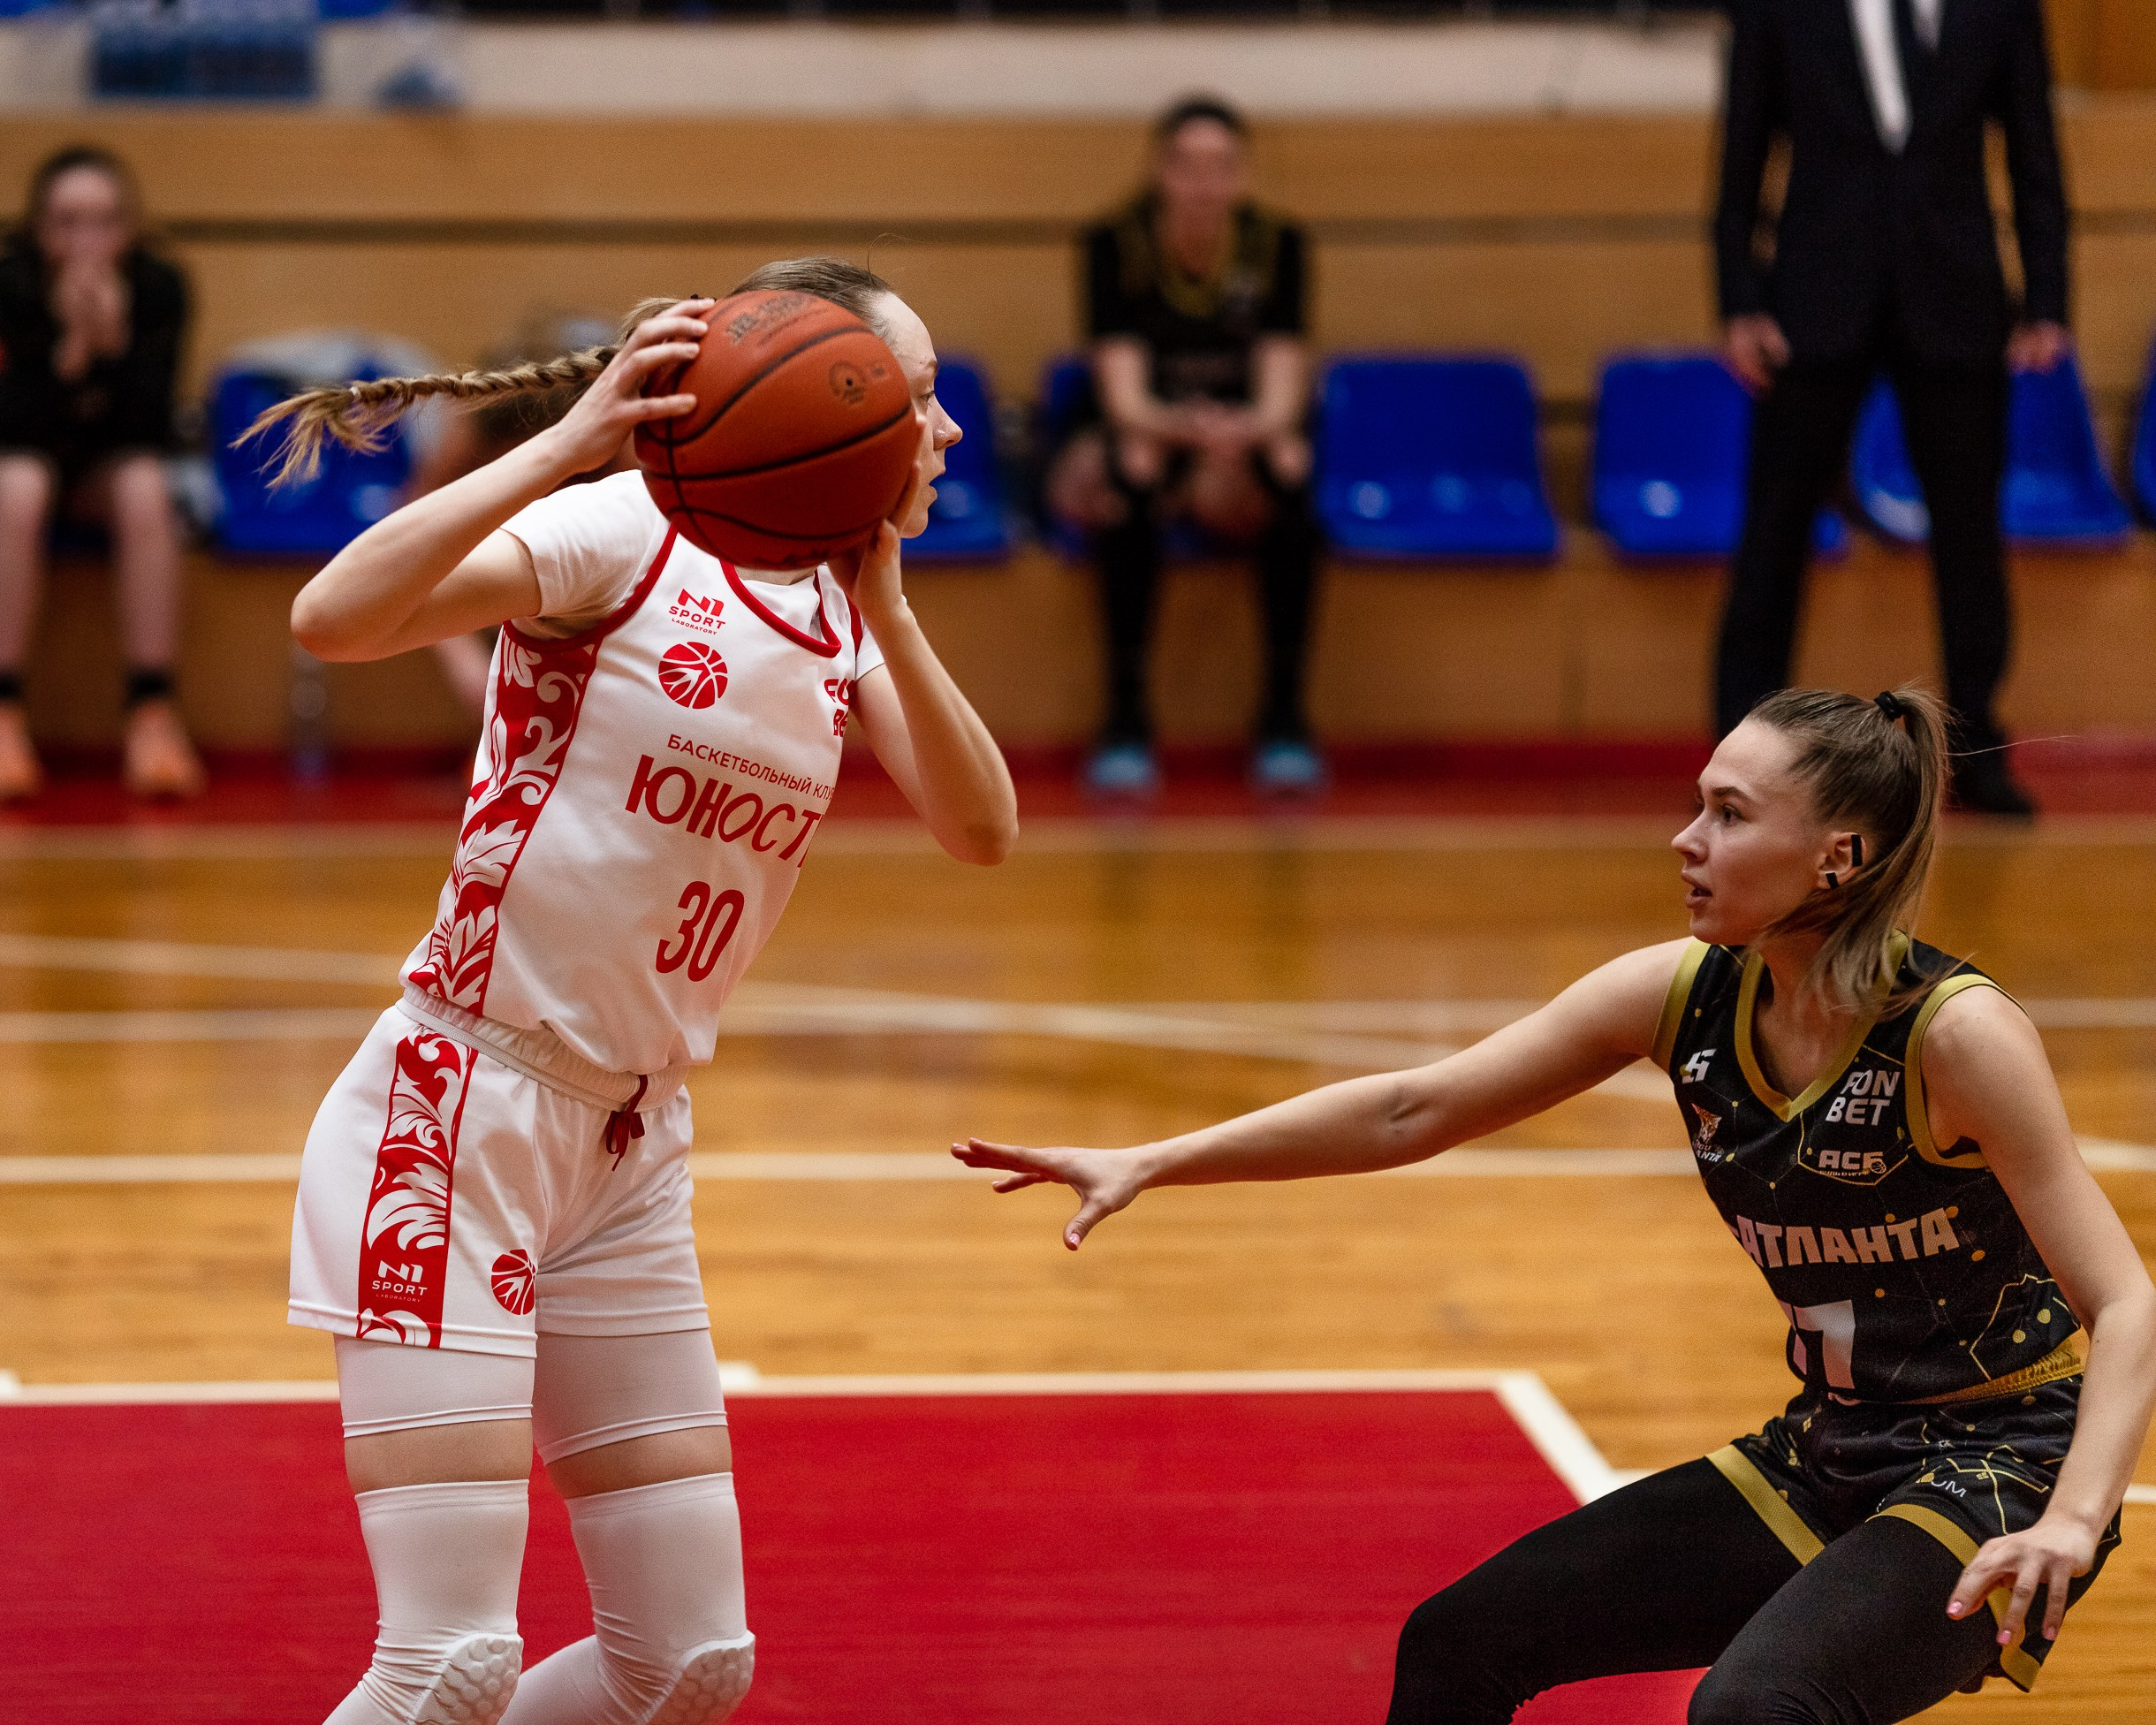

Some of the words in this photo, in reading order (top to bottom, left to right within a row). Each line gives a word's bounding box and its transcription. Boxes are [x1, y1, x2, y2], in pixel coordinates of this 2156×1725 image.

[669, 605, 726, 629] SPORT
[672, 618, 717, 635] LABORATORY
[667, 733, 812, 794] БАСКЕТБОЛЬНЫЙ
[625, 753, 824, 868] ЮНОСТ
[656, 880, 745, 982] 30
[1840, 1069, 1901, 1097] FON
[1825, 1097, 1891, 1126] BET
[371, 1280, 428, 1296] SPORT
[376, 1293, 421, 1303] LABORATORY
